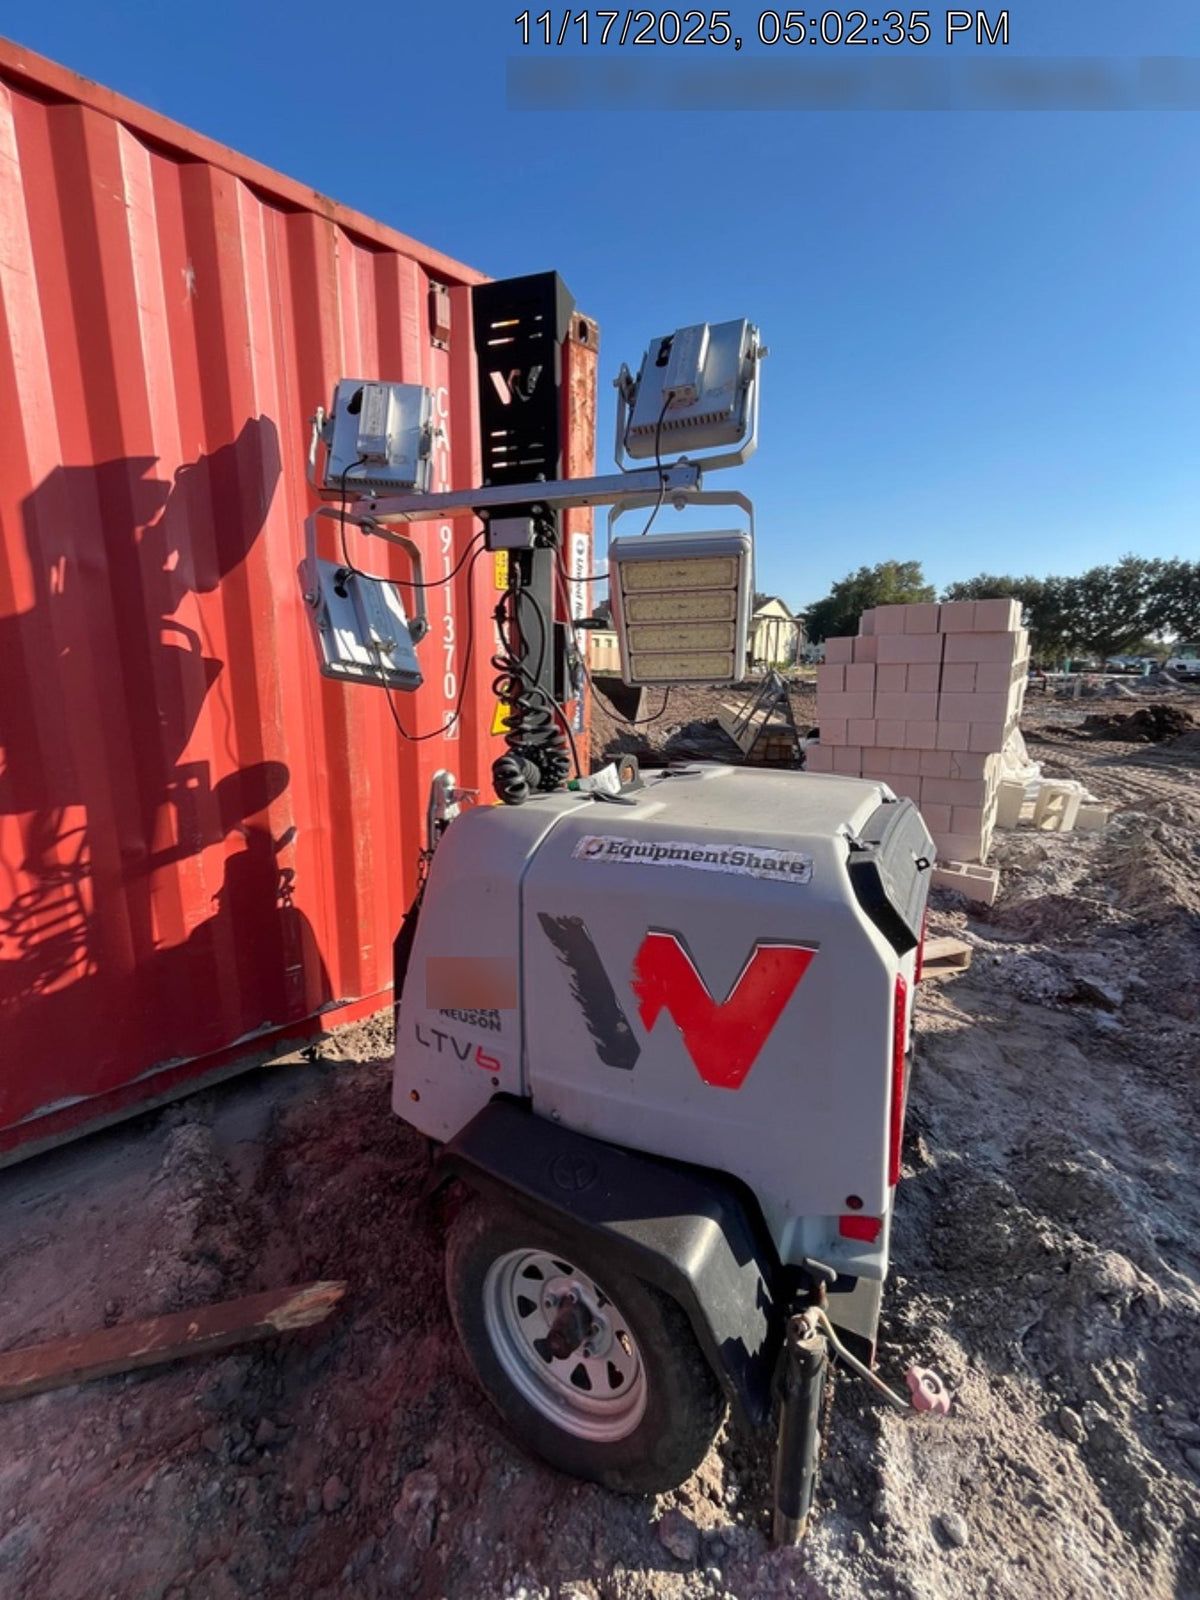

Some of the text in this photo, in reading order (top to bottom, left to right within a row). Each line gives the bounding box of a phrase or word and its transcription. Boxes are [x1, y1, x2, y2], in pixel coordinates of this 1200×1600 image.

[440, 525, 457, 700] 911370
[607, 841, 806, 875] EquipmentShare
[415, 1023, 501, 1073] LTV6
